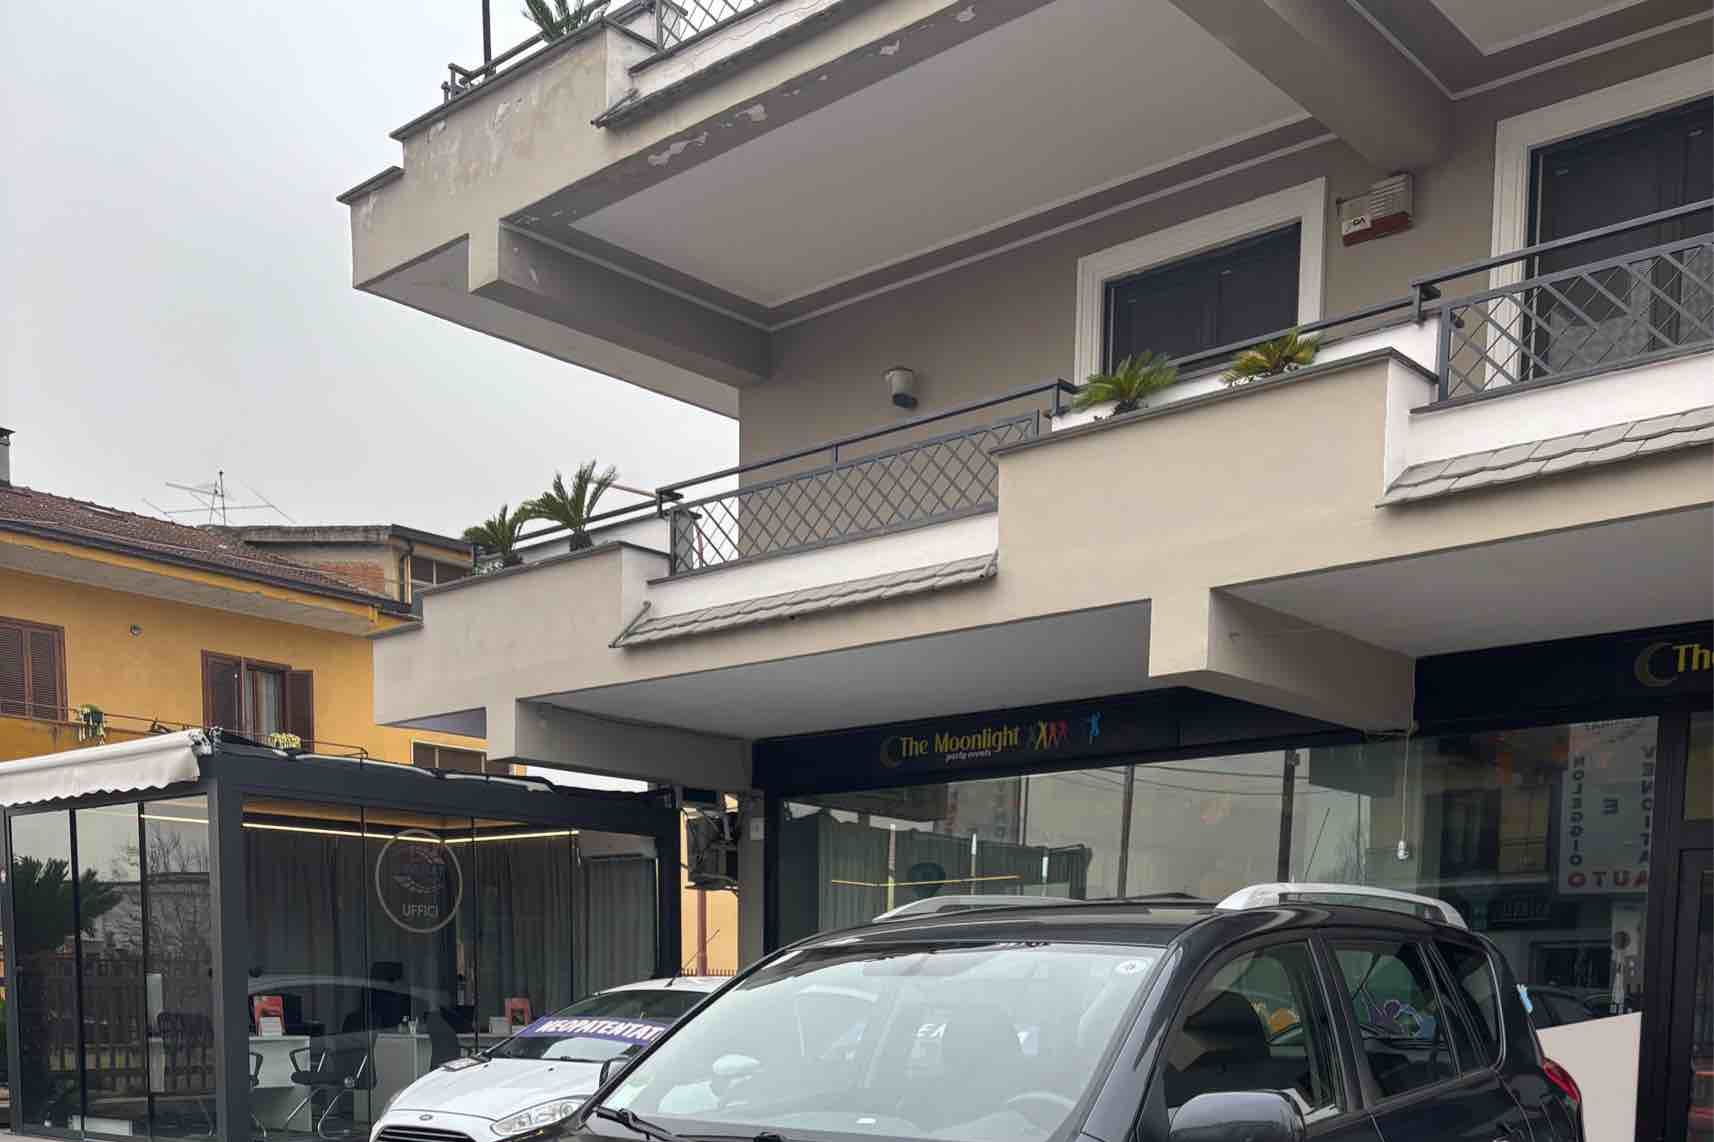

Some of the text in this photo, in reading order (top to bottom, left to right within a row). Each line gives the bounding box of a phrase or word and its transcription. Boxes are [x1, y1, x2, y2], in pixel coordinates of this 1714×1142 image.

[1671, 643, 1714, 673] Th
[900, 725, 1020, 758] The Moonlight
[402, 903, 439, 918] UFFICI
